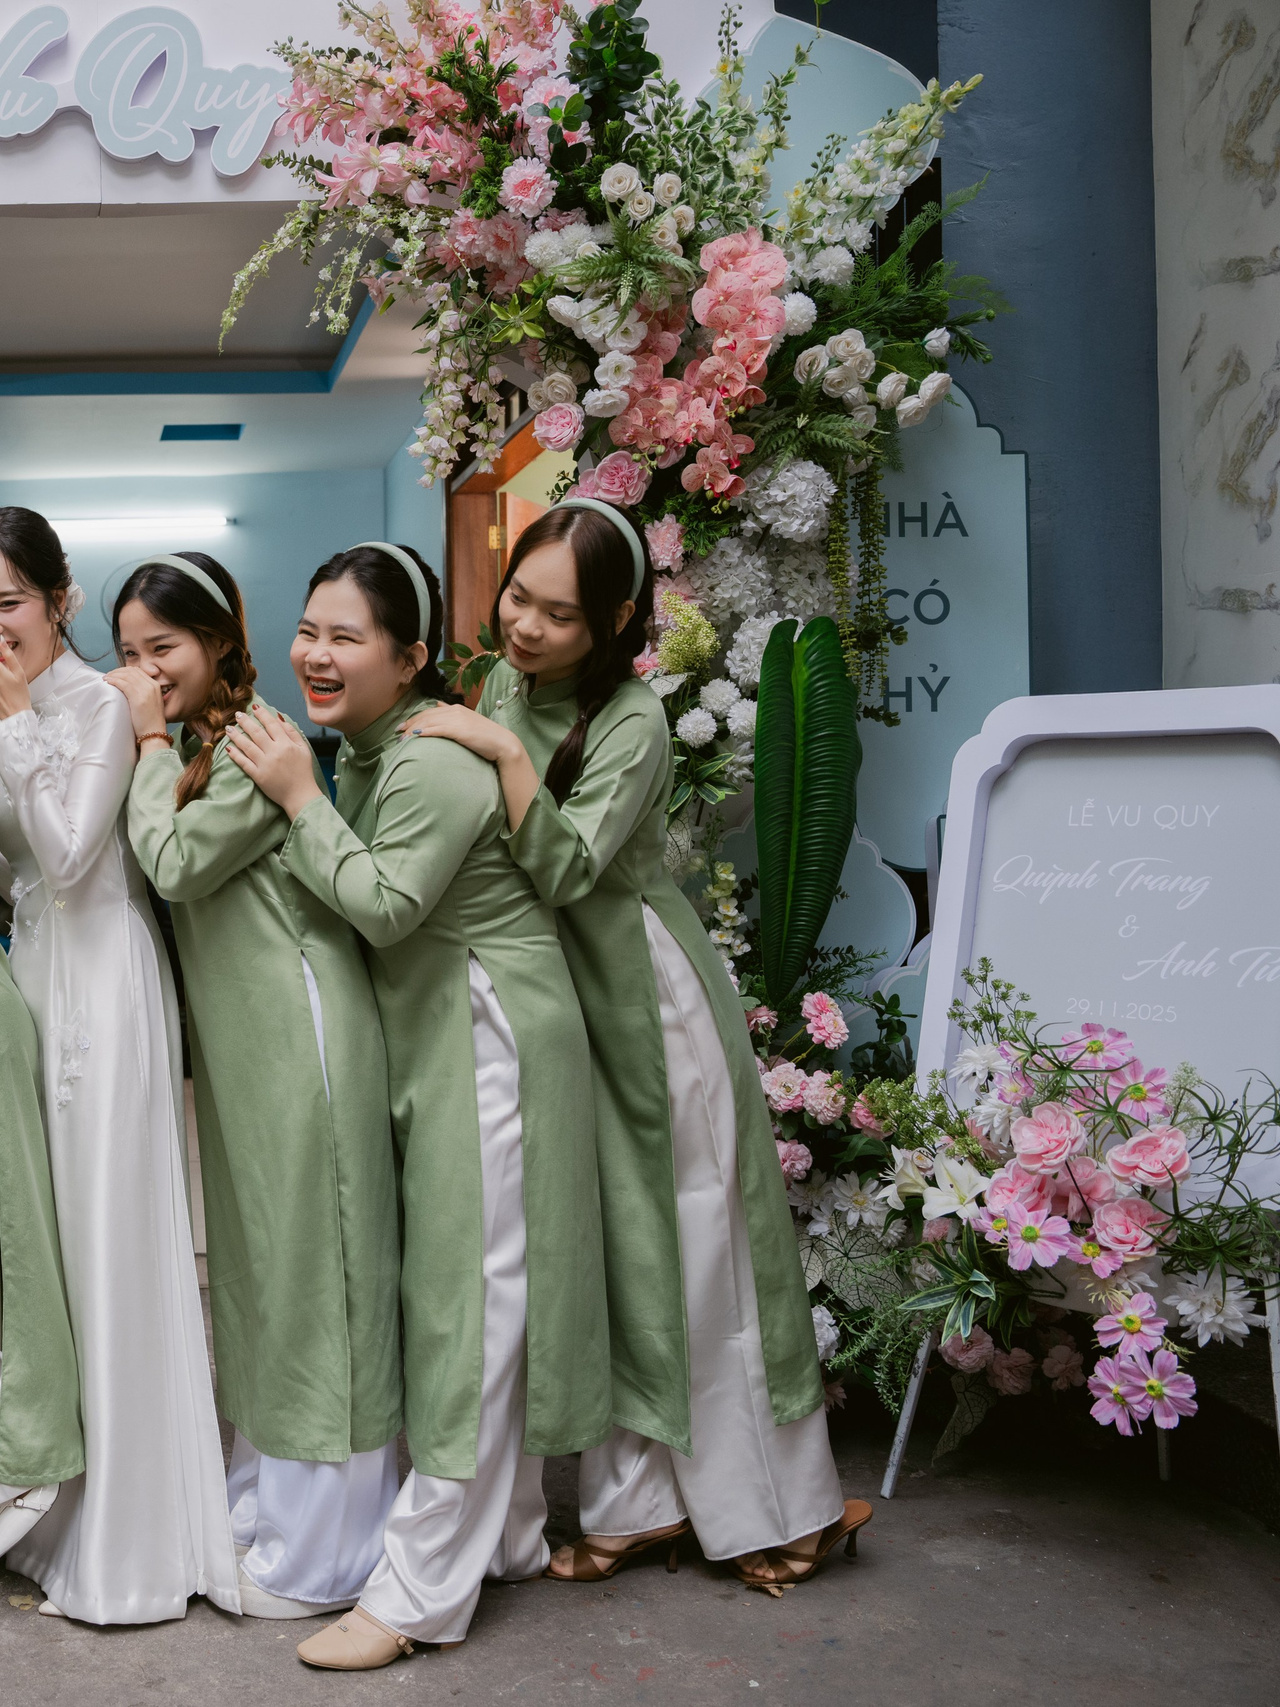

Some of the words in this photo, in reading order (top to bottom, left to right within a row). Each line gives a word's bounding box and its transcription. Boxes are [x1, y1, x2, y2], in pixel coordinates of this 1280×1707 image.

[87, 18, 289, 161] Quy
[880, 578, 951, 626] CÓ
[882, 663, 951, 713] HỶ
[1067, 799, 1095, 827] LỄ
[1106, 805, 1141, 827] VU
[1153, 804, 1221, 831] QUY
[992, 854, 1101, 905] Quỳnh
[1108, 857, 1213, 911] Trang
[1118, 914, 1140, 938] &
[1122, 941, 1221, 981] Anh
[1065, 998, 1177, 1023] 29.11.2025
